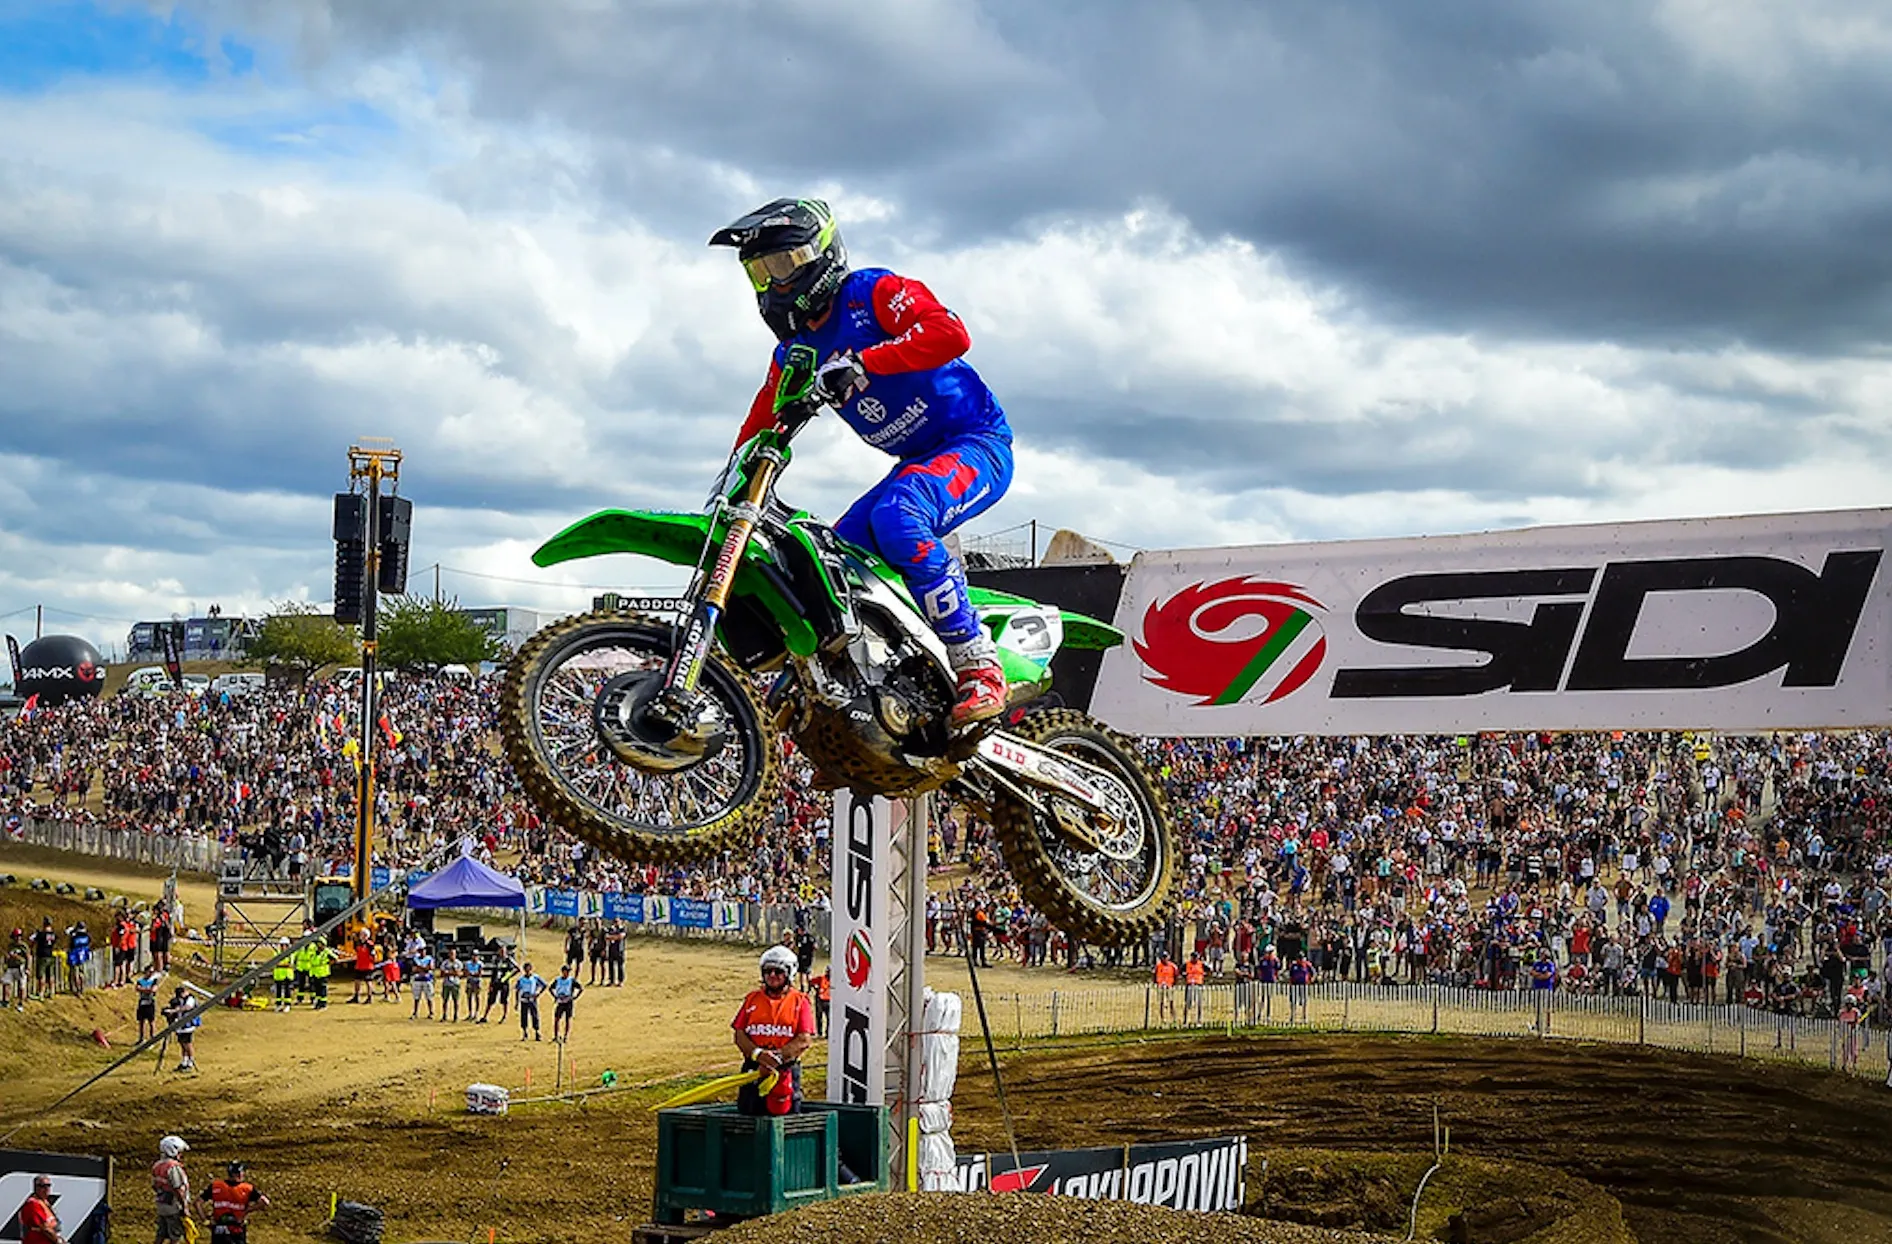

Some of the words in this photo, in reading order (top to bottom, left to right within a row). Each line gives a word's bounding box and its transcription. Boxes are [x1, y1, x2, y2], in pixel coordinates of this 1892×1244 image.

[619, 598, 690, 611] PADDOC
[1329, 548, 1884, 698] SIDI
[672, 618, 703, 690] DUNLOP
[1010, 615, 1051, 651] 3
